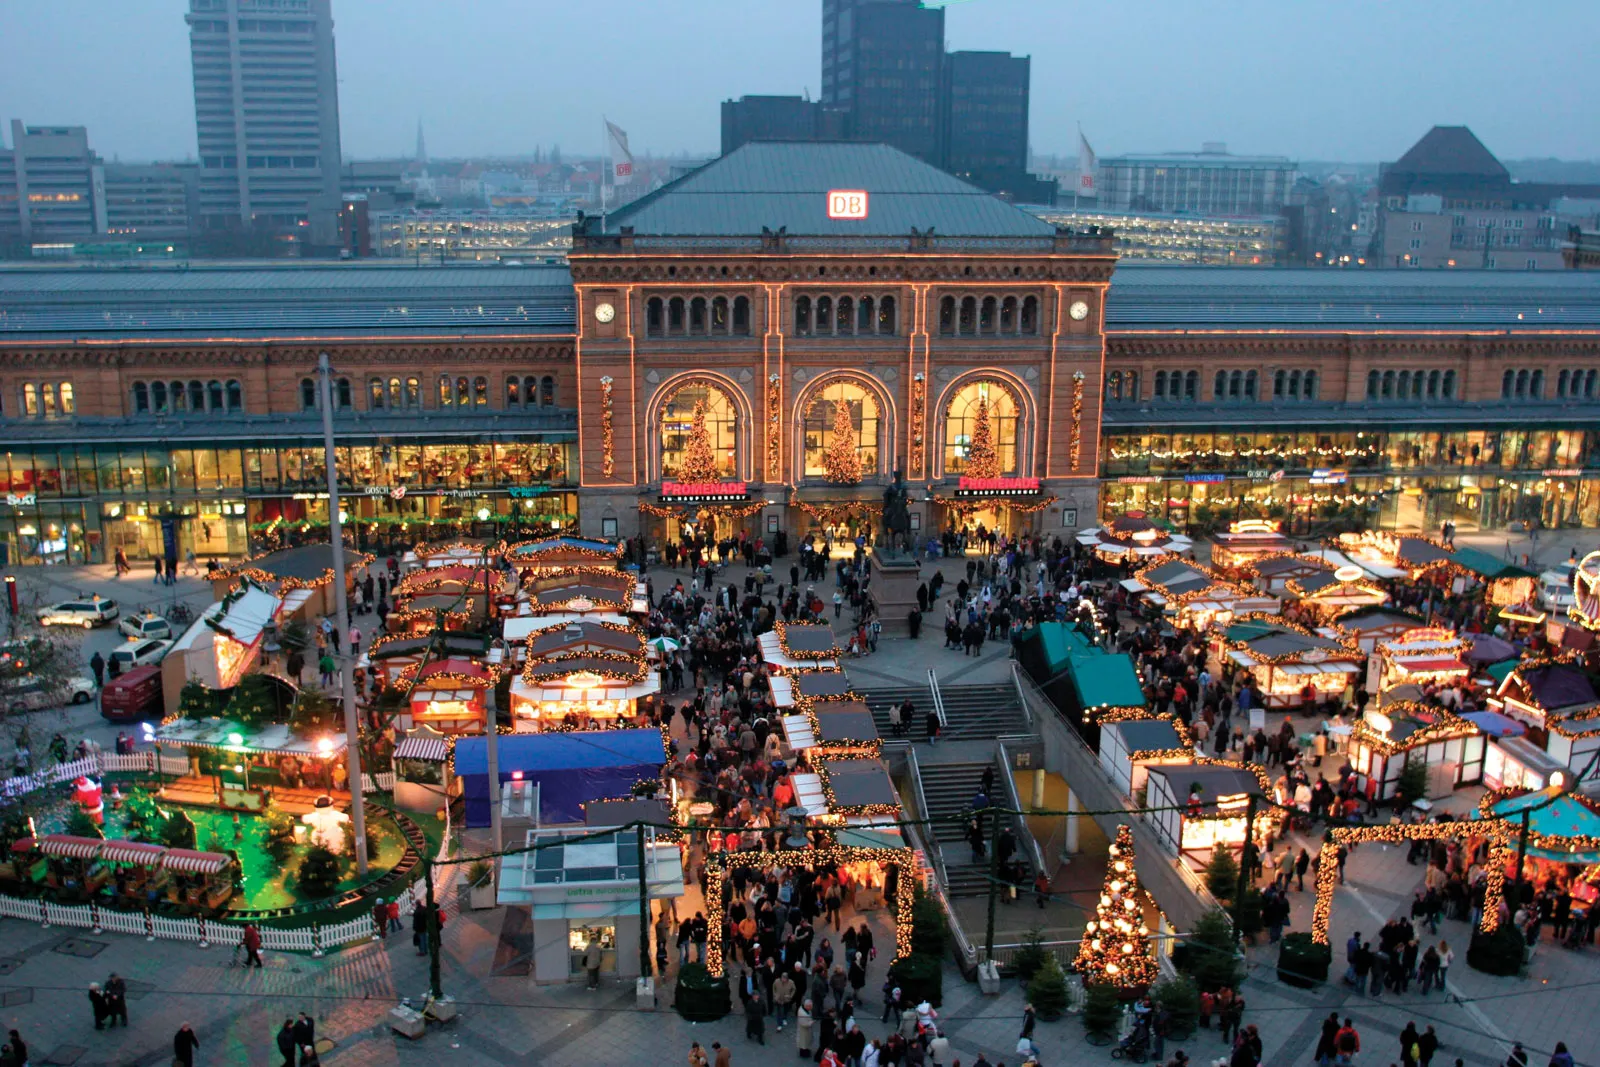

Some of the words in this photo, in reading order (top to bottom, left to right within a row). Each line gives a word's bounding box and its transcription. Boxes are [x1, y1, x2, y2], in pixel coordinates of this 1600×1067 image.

[833, 196, 862, 214] DB
[365, 486, 389, 494] GOSCH
[662, 482, 747, 496] PROMENADE
[959, 476, 1039, 490] PROMENADE
